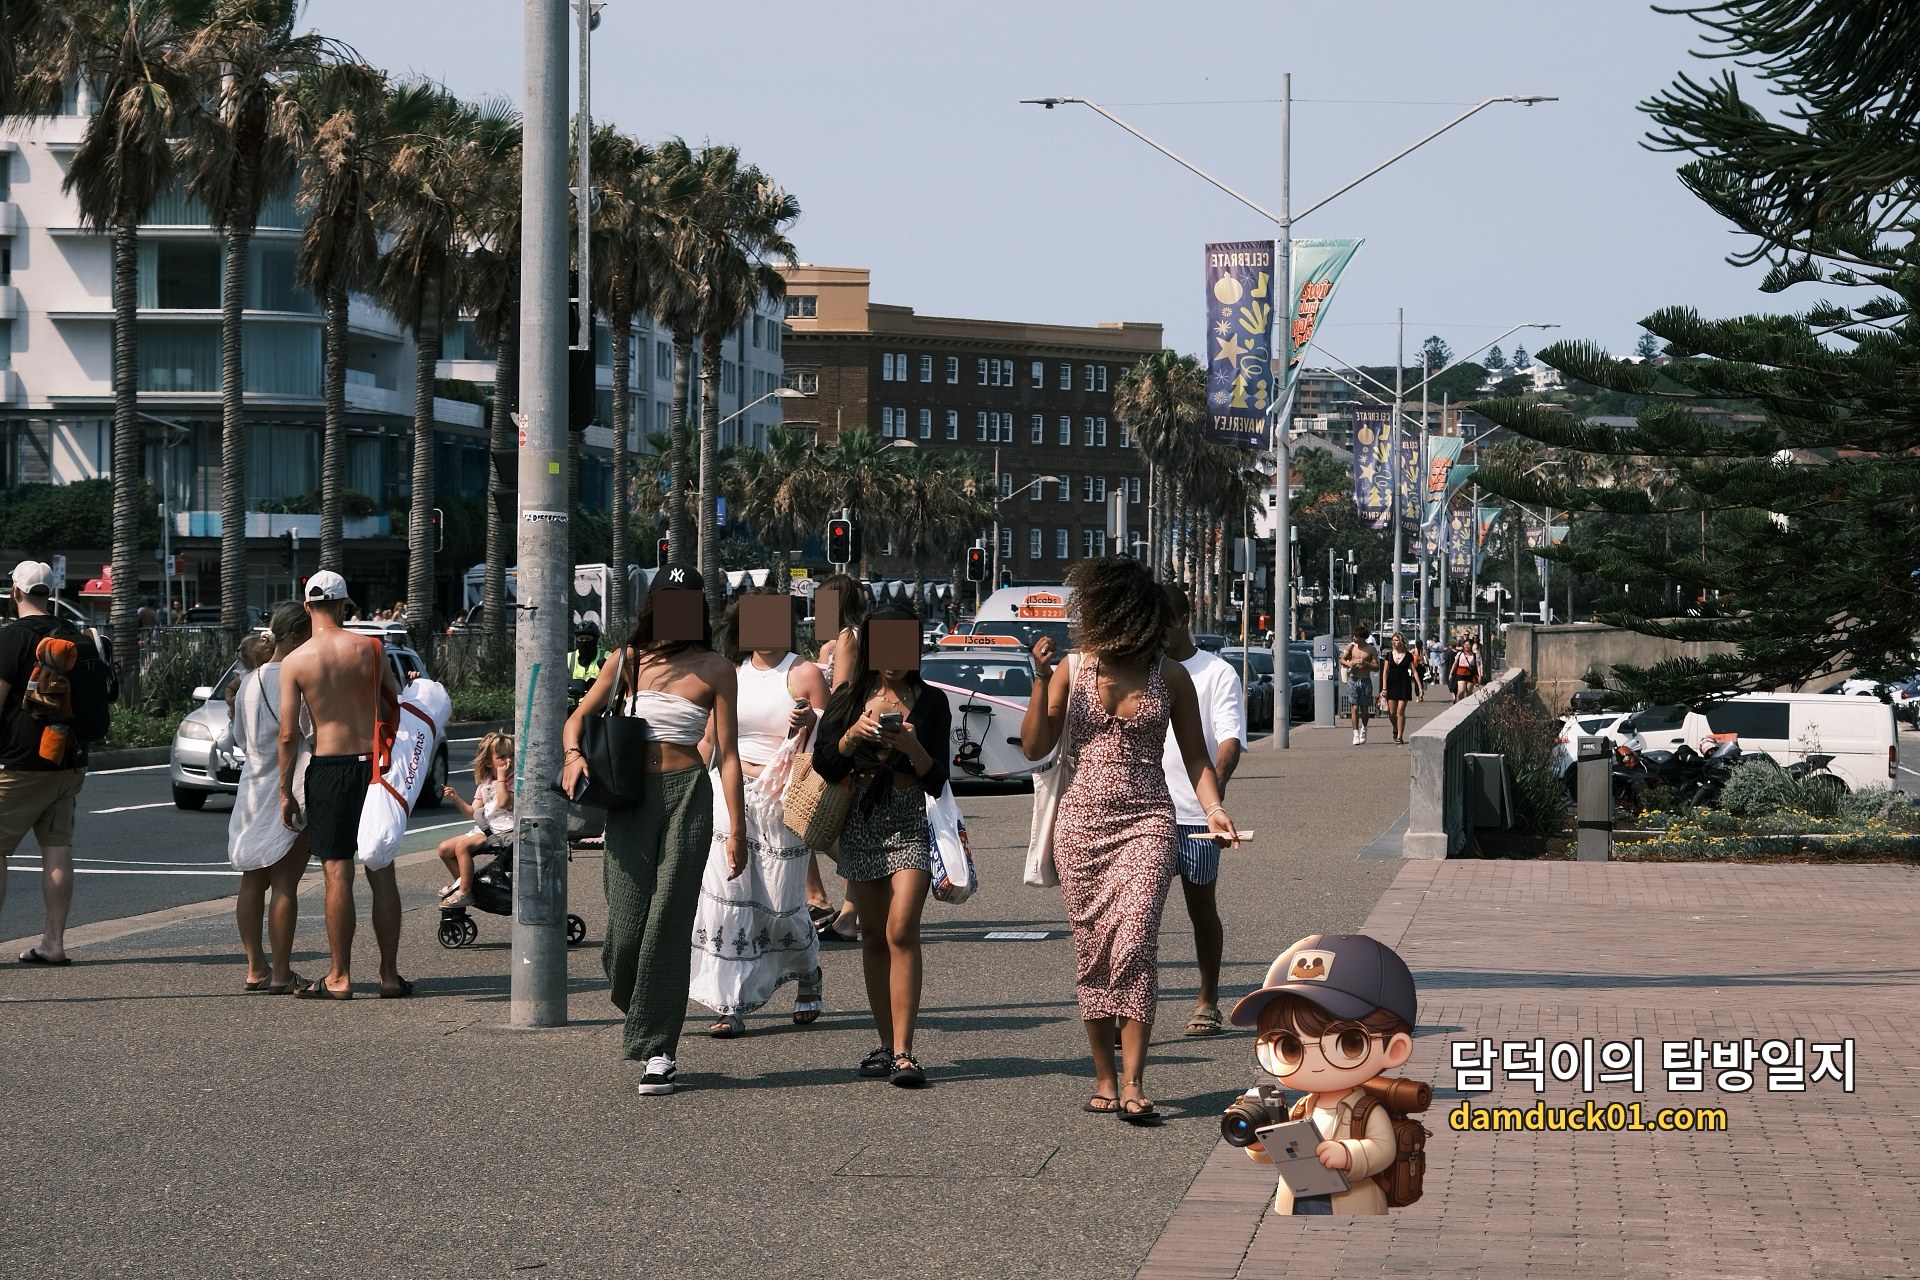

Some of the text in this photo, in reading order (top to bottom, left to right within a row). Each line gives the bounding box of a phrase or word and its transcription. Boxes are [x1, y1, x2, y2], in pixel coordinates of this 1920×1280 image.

[669, 567, 685, 583] NY
[1029, 595, 1057, 604] 13cabs
[1042, 609, 1063, 617] 2227
[964, 636, 996, 645] 13cabs
